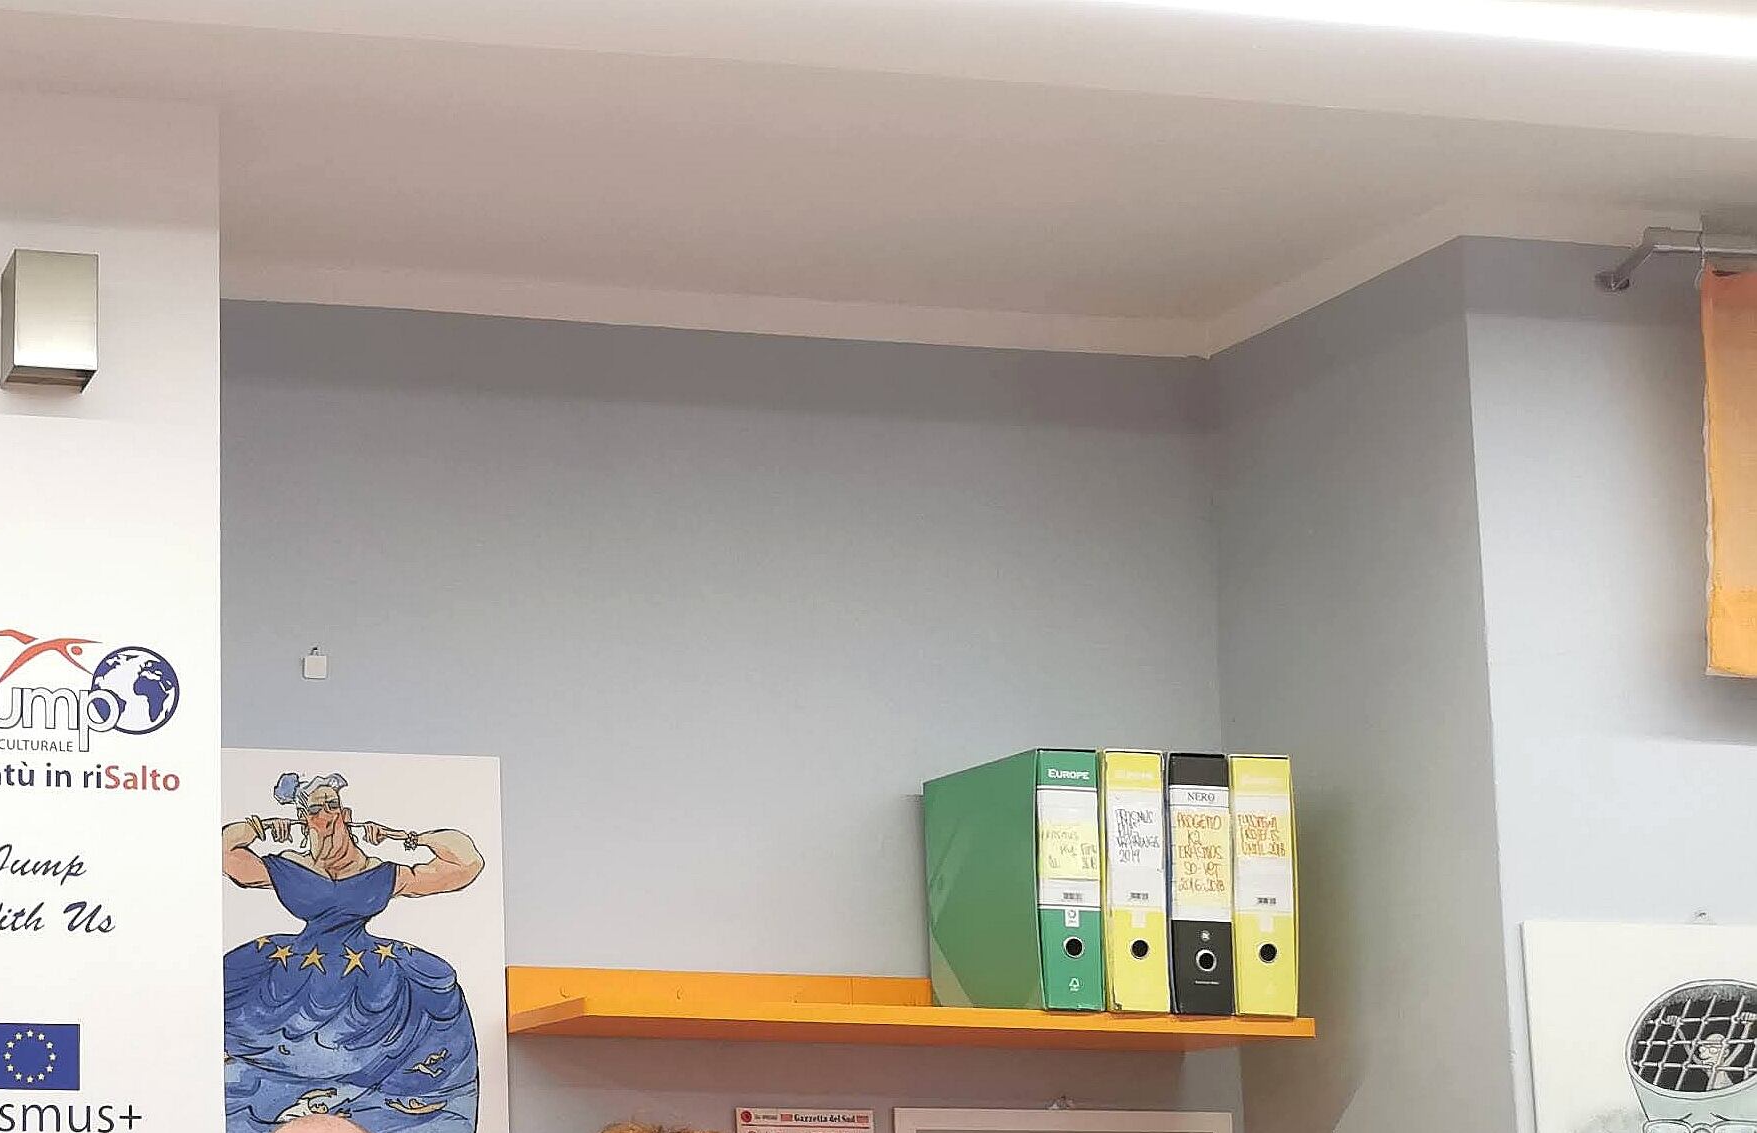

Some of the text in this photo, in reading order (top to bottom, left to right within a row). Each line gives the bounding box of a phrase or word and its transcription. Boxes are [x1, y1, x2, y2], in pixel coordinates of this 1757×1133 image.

[45, 762, 72, 788] in
[83, 762, 181, 792] riSalto
[1047, 768, 1091, 780] EUROPE
[1187, 792, 1215, 802] NERO
[63, 900, 116, 934] Us
[794, 1113, 855, 1123] Gazzetta del Sud
